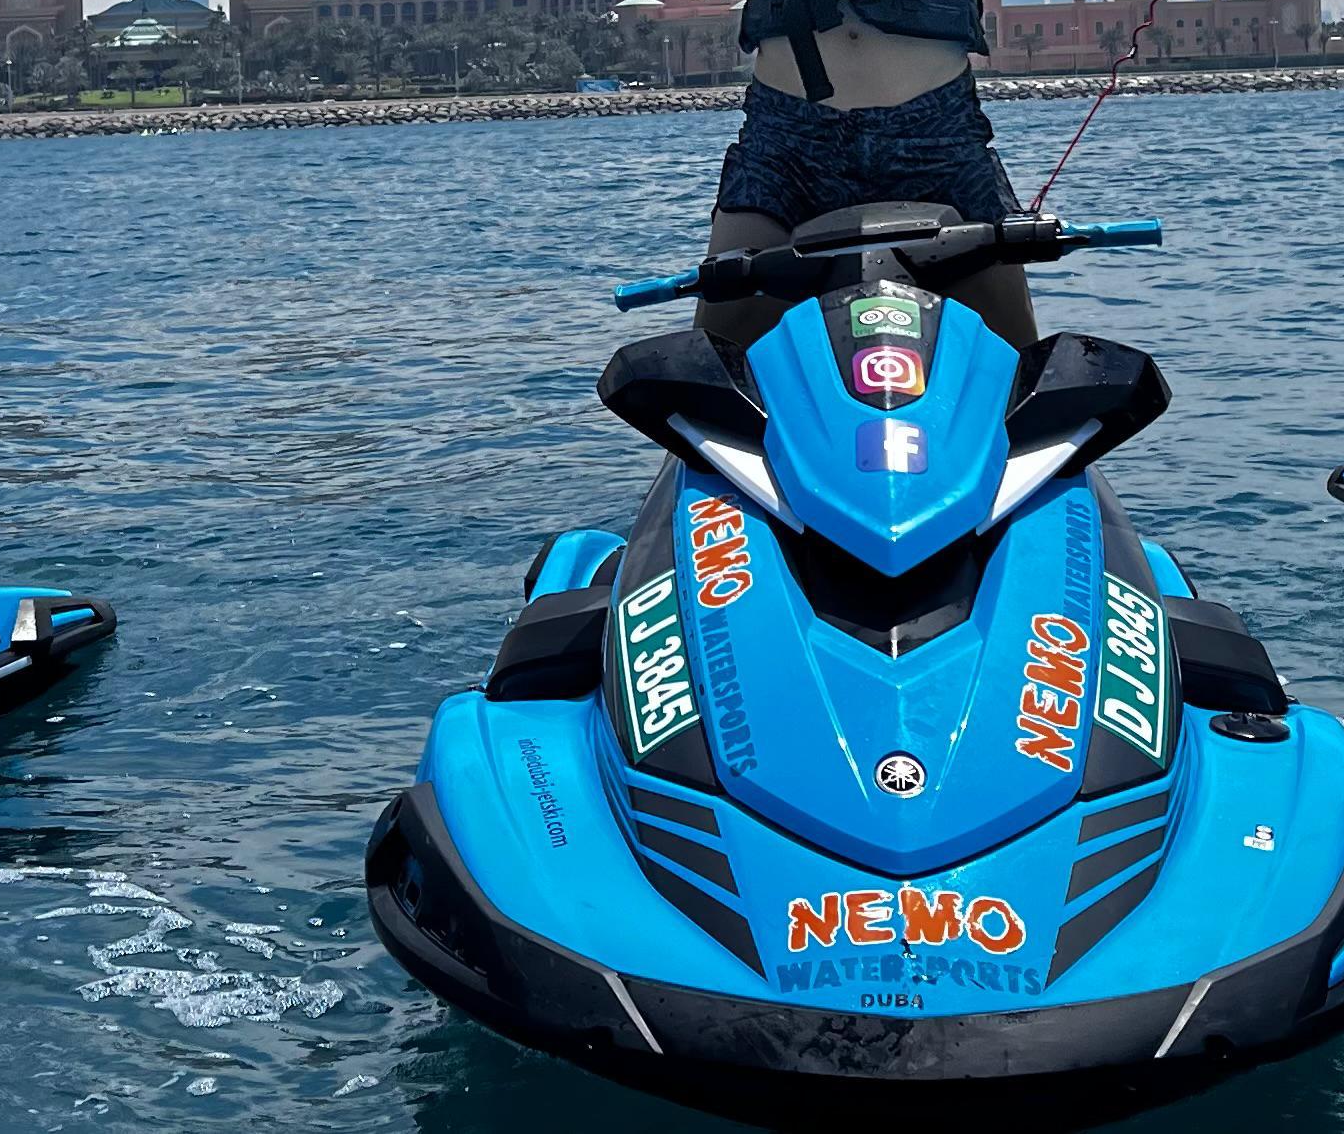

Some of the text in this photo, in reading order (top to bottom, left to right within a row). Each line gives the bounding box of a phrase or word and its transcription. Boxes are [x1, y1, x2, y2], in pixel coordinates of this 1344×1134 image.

[627, 578, 693, 735] D J 3845
[688, 494, 758, 777] NEMO WATERSPORTS
[1015, 500, 1092, 772] NEMO WATERSPORTS
[1104, 581, 1156, 744] D J 3845
[788, 888, 1026, 954] NEMO
